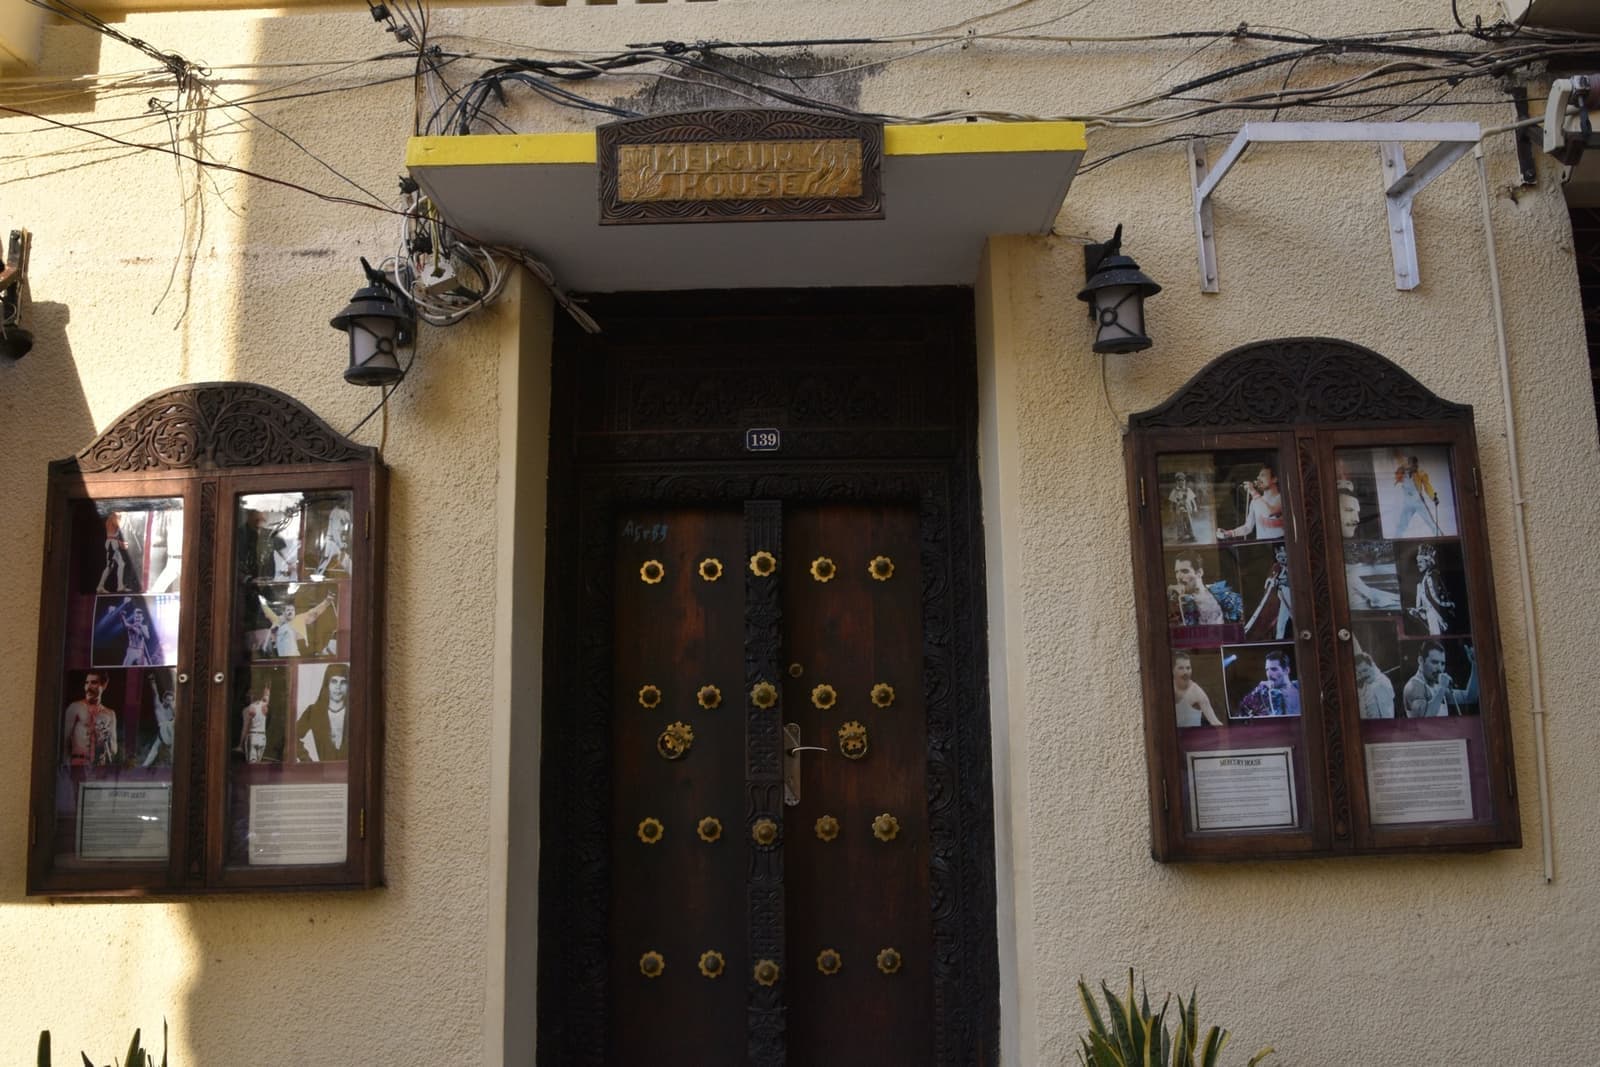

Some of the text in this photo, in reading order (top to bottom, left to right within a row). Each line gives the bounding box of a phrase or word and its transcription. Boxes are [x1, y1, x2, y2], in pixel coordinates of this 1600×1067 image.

[654, 143, 823, 173] MERCURY
[680, 172, 801, 198] HOUSE
[751, 433, 777, 447] 139
